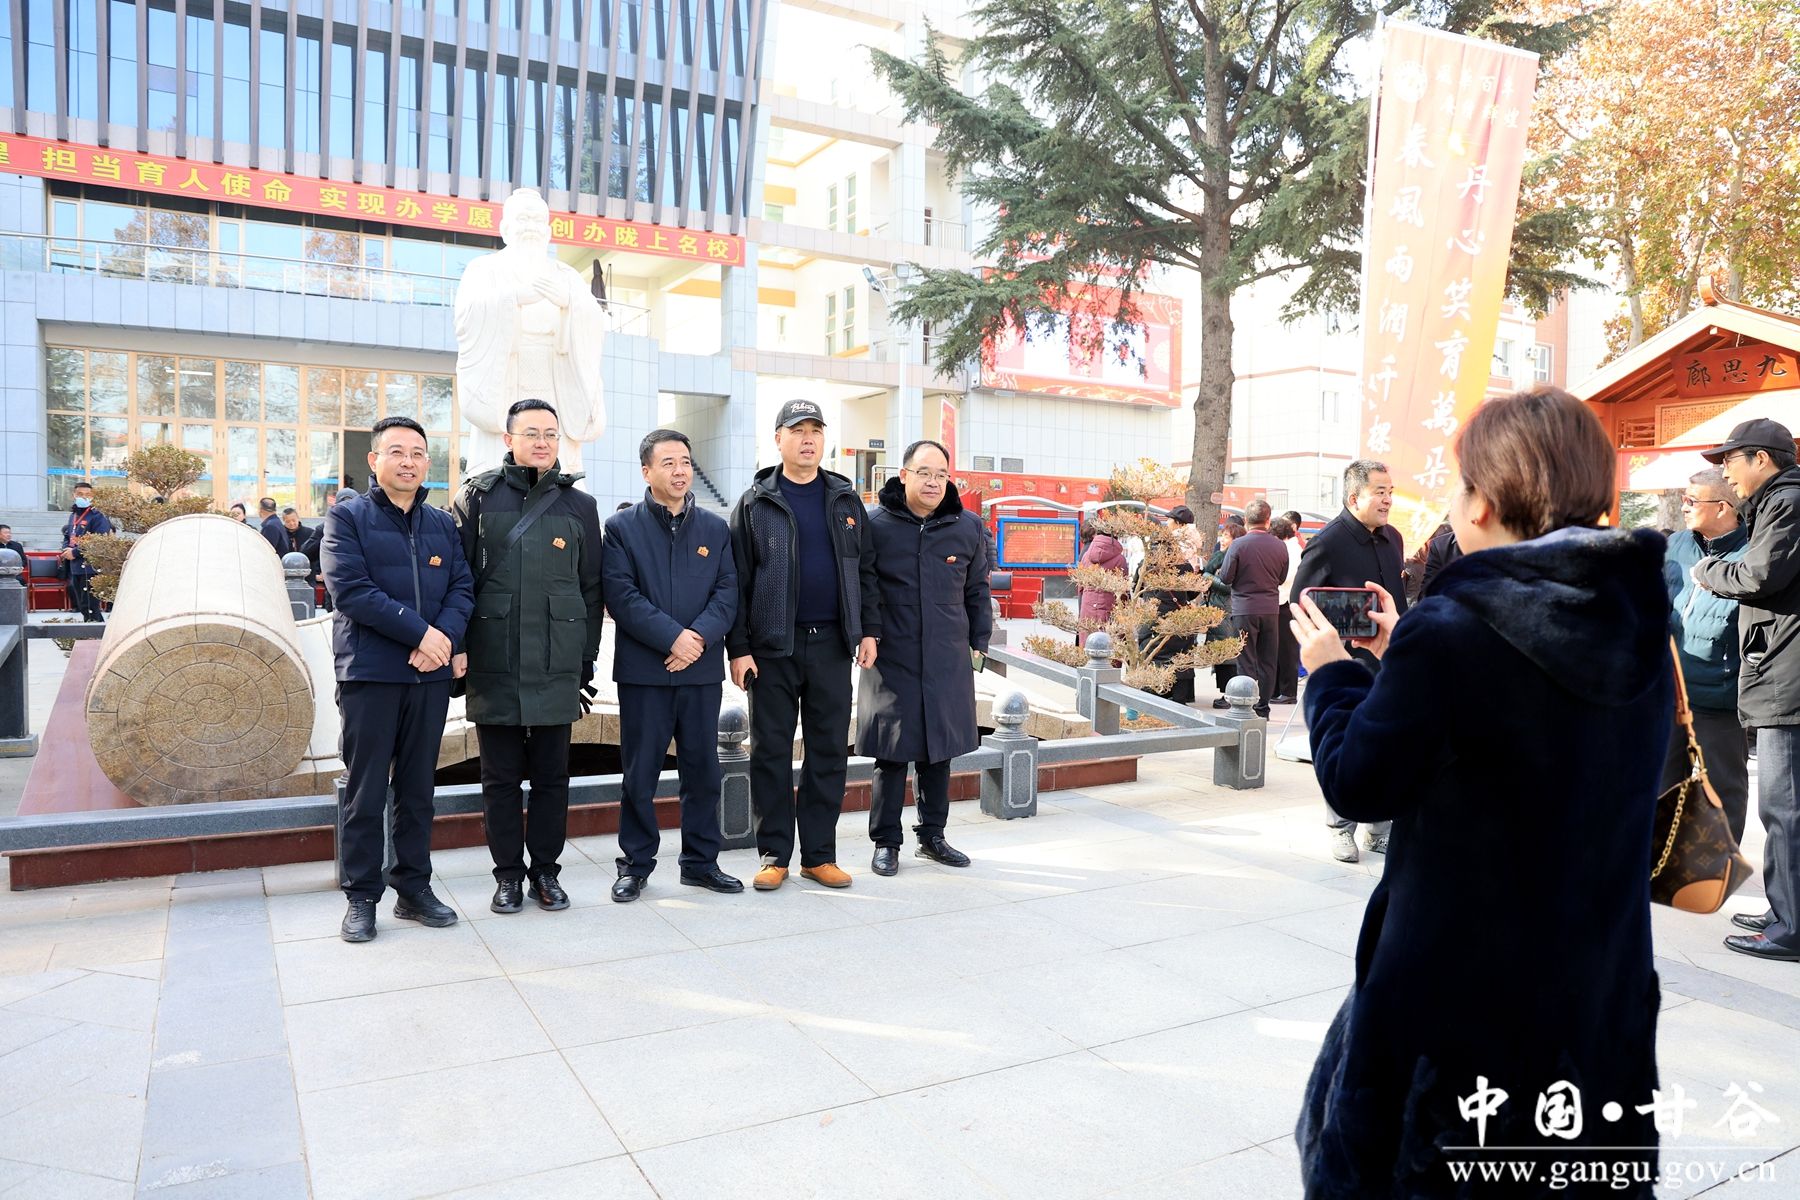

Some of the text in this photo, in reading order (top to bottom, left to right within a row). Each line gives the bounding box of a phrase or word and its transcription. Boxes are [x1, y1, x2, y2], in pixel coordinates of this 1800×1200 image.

[42, 146, 293, 203] 担当育人使命
[319, 186, 493, 229] 实现办学愿
[551, 218, 730, 260] 创办陇上名校
[1686, 354, 1787, 390] 九思廊
